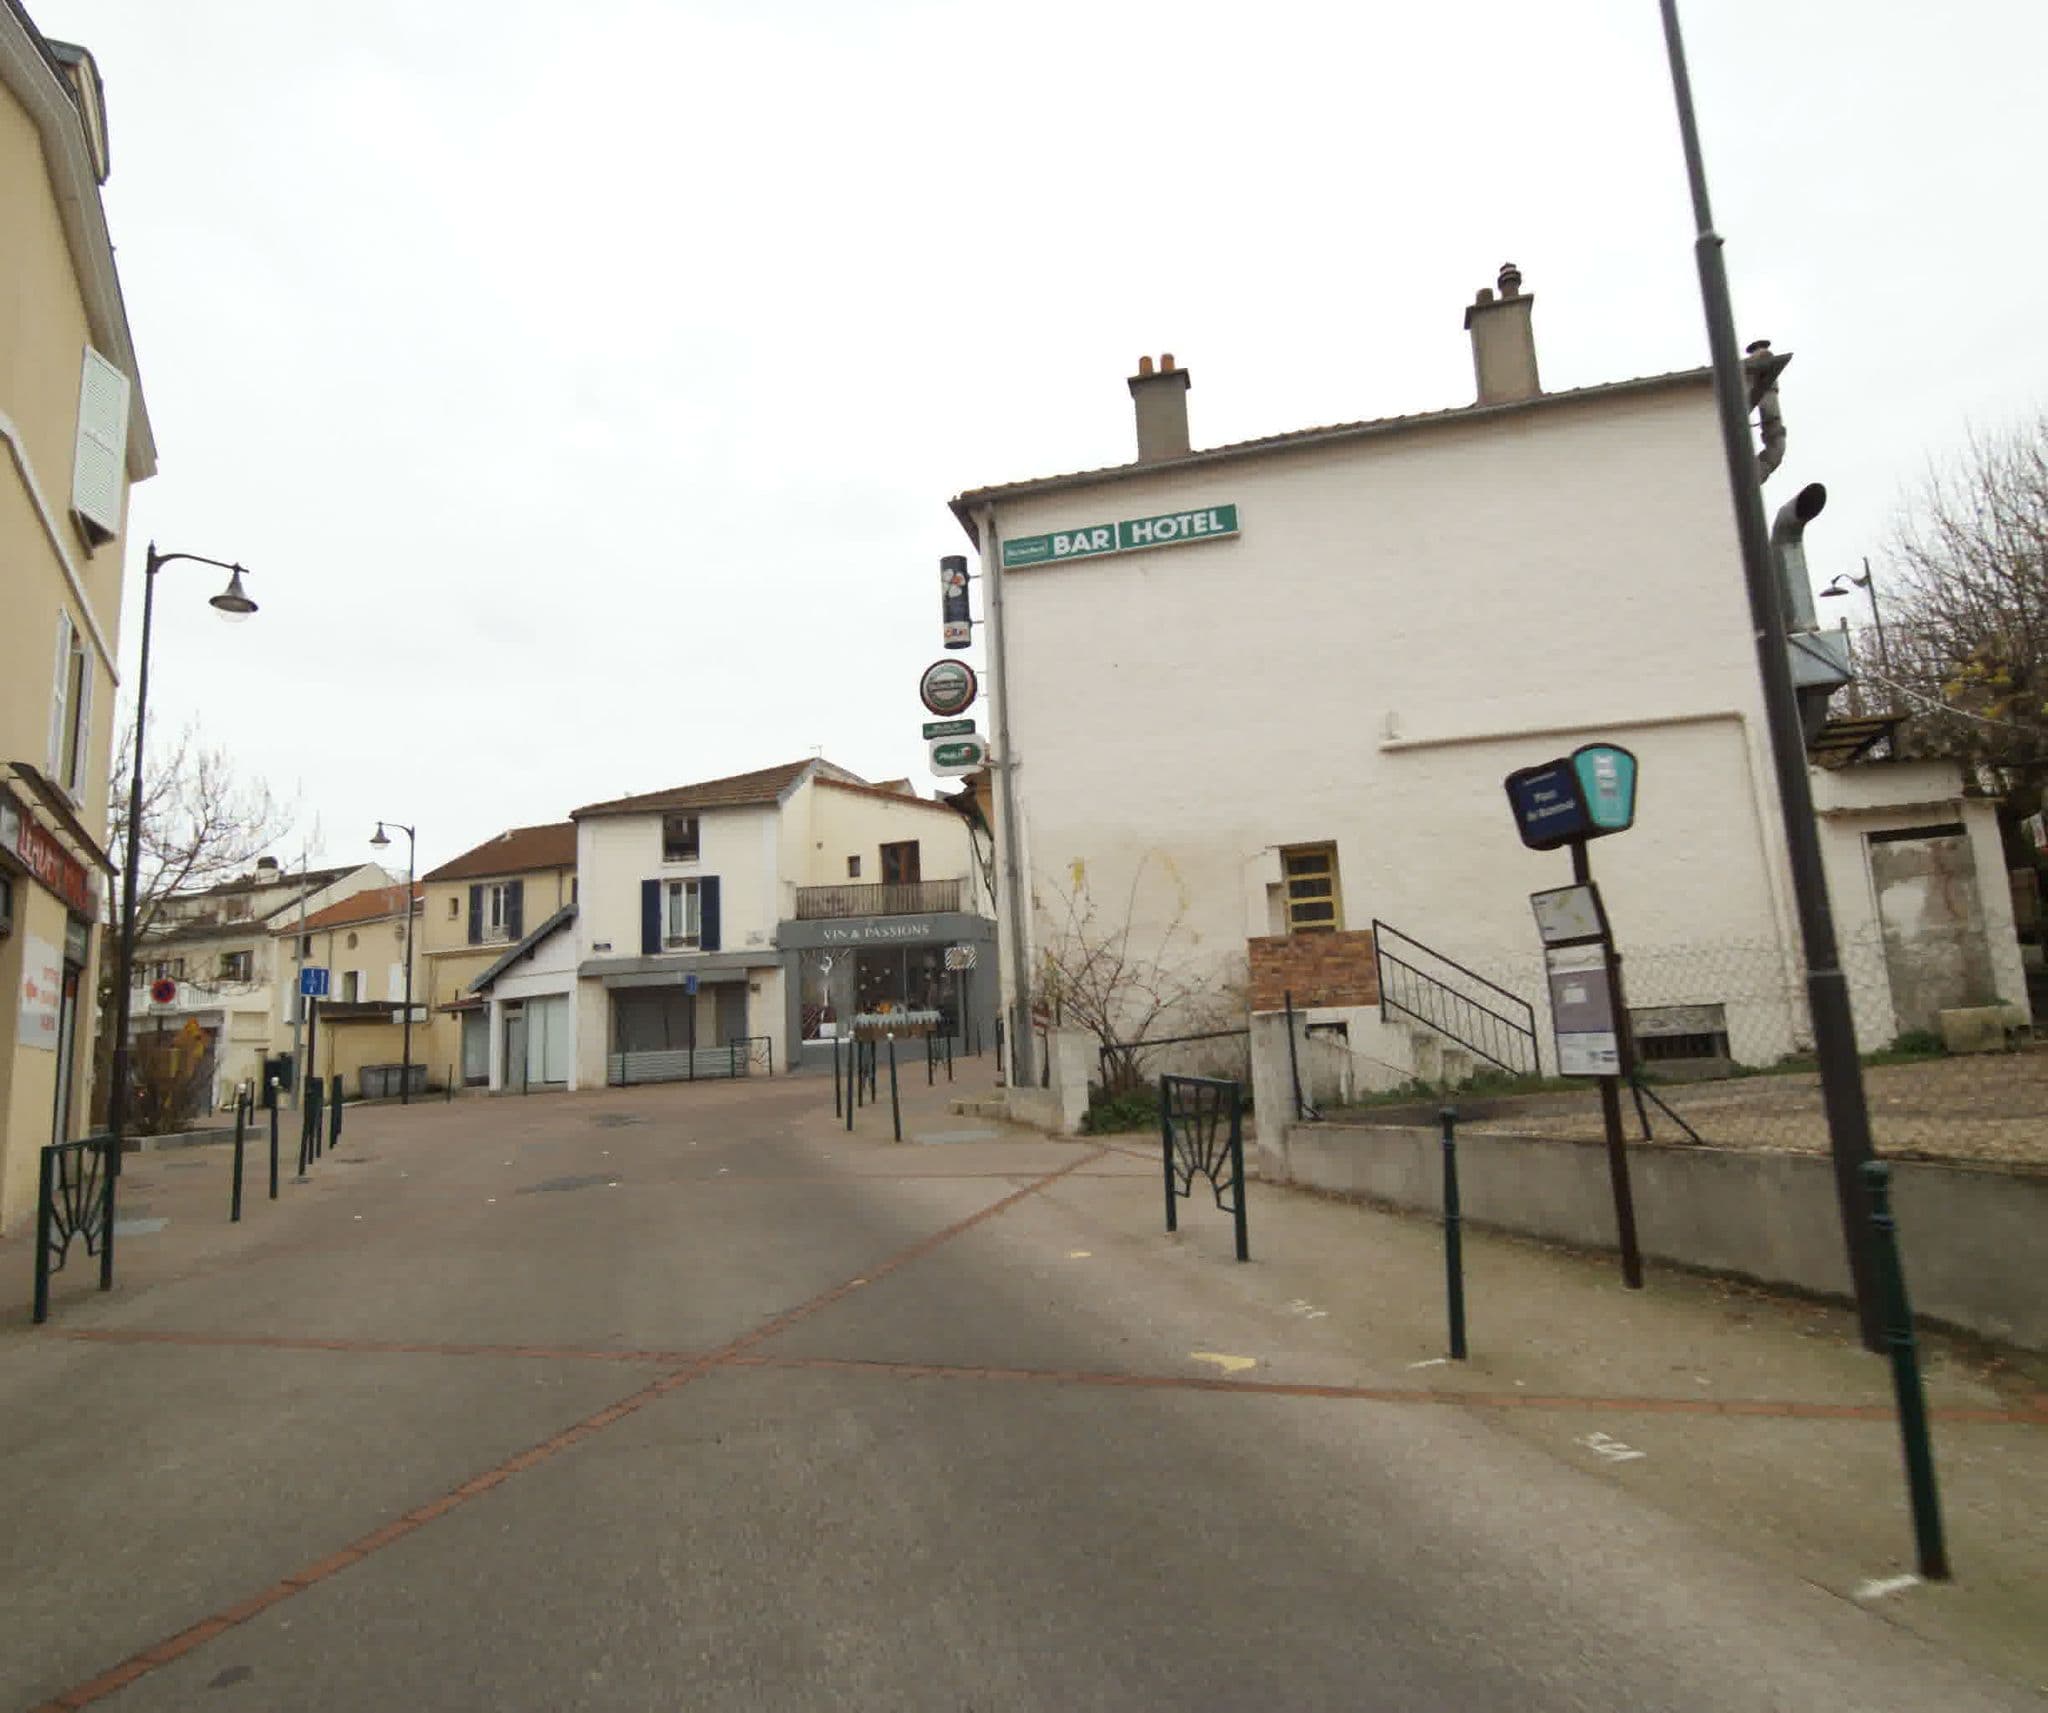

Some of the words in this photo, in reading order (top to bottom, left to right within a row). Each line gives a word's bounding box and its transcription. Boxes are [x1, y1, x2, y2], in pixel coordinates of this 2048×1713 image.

[1053, 529, 1110, 556] BAR
[1131, 510, 1224, 544] HOTEL
[823, 929, 847, 940] VIN
[864, 924, 930, 938] PASSIONS
